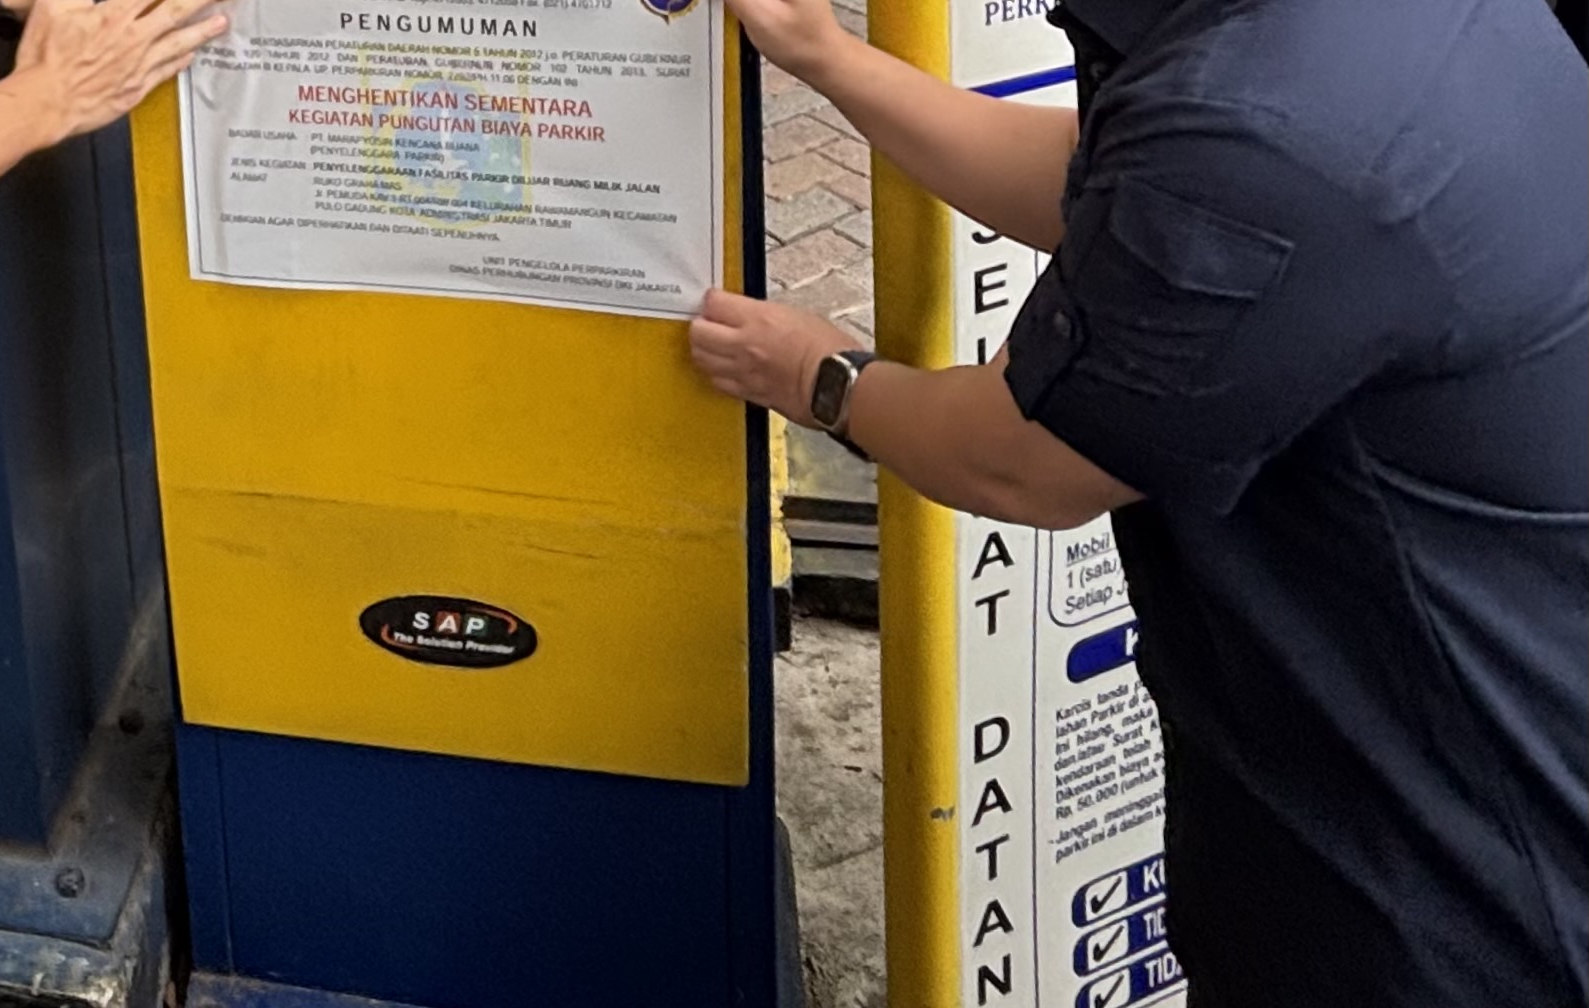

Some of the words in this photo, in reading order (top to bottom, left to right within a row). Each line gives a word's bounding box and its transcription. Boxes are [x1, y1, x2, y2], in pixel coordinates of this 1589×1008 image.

[340, 12, 538, 38] PENGUMUMAN
[562, 50, 627, 63] PERATURAN
[577, 64, 612, 76] TAHUN
[298, 85, 458, 111] MENGHENTIKAN
[463, 93, 593, 118] SEMENTARA
[288, 109, 373, 128] KEGIATAN
[378, 114, 475, 134] PUNGUTAN
[481, 119, 532, 138] BIAYA
[537, 122, 606, 143] PARKIR
[625, 181, 661, 194] JALAN
[1067, 532, 1110, 562] Mobil
[1067, 569, 1074, 589] 1
[1065, 584, 1113, 615] Setiap
[412, 610, 487, 636] SAP
[1090, 701, 1126, 725] Parkir
[1112, 724, 1144, 748] Surat
[1055, 837, 1090, 865] parkir
